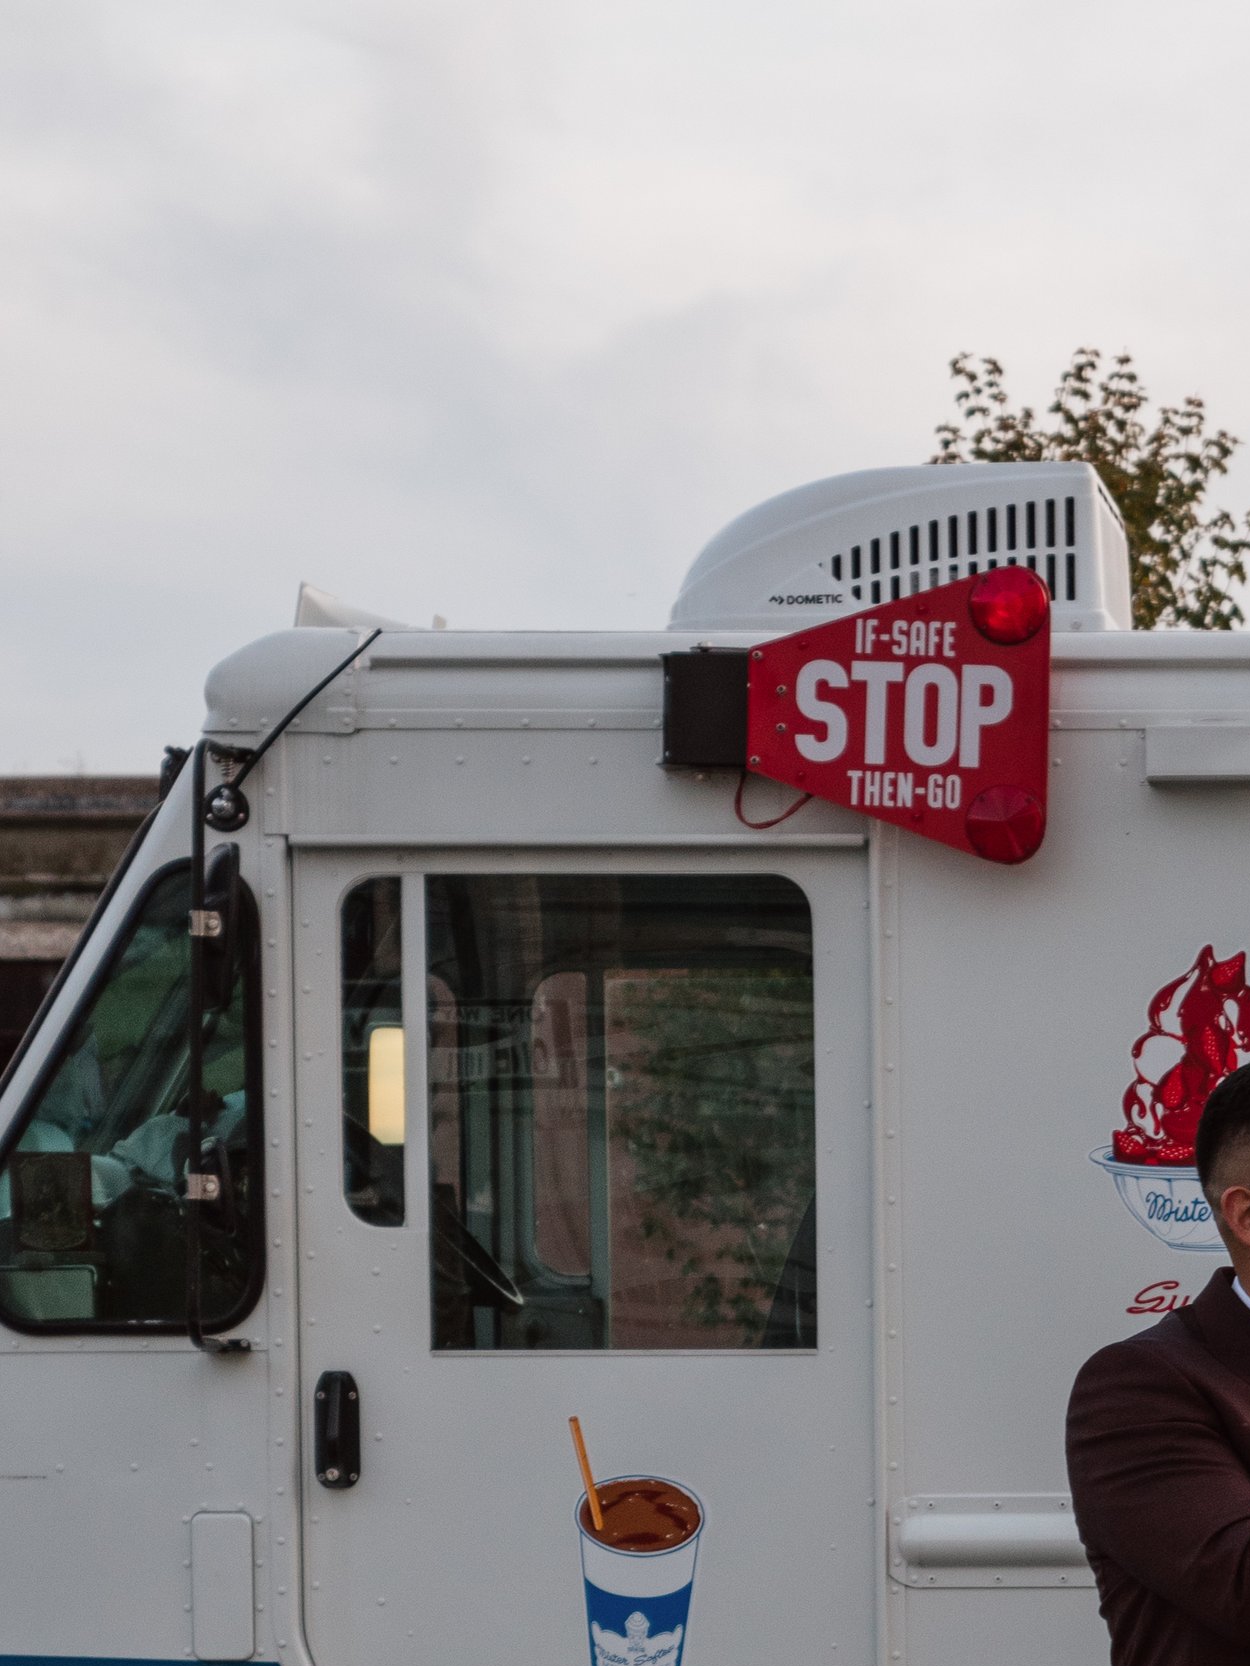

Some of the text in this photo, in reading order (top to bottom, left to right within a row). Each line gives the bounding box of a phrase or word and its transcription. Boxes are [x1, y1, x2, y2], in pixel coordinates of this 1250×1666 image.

[786, 593, 843, 606] DOMETIC
[854, 618, 957, 658] IF-SAFE
[793, 659, 1014, 768] STOP
[847, 769, 962, 810] THEN-GO
[1146, 1191, 1214, 1223] Miste
